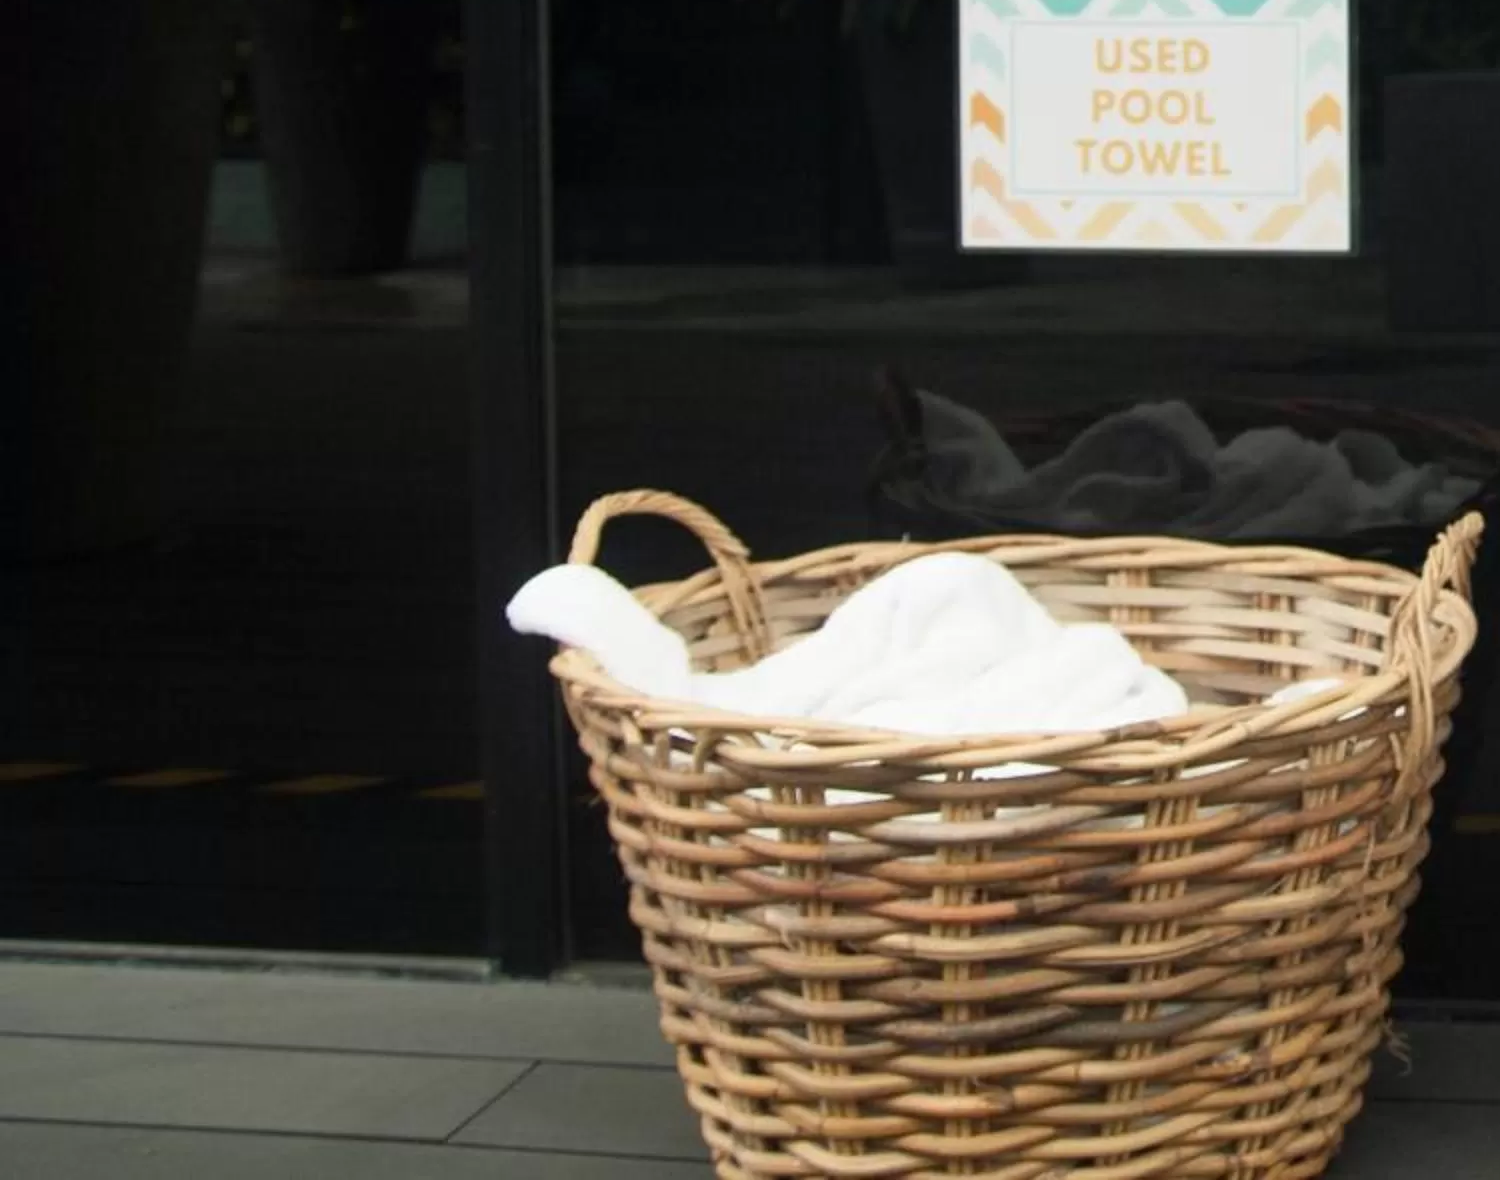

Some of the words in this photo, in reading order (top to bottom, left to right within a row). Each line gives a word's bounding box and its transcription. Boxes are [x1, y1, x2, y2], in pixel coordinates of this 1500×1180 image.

[1093, 37, 1211, 75] USED
[1091, 87, 1216, 126] POOL
[1074, 138, 1231, 178] TOWEL
